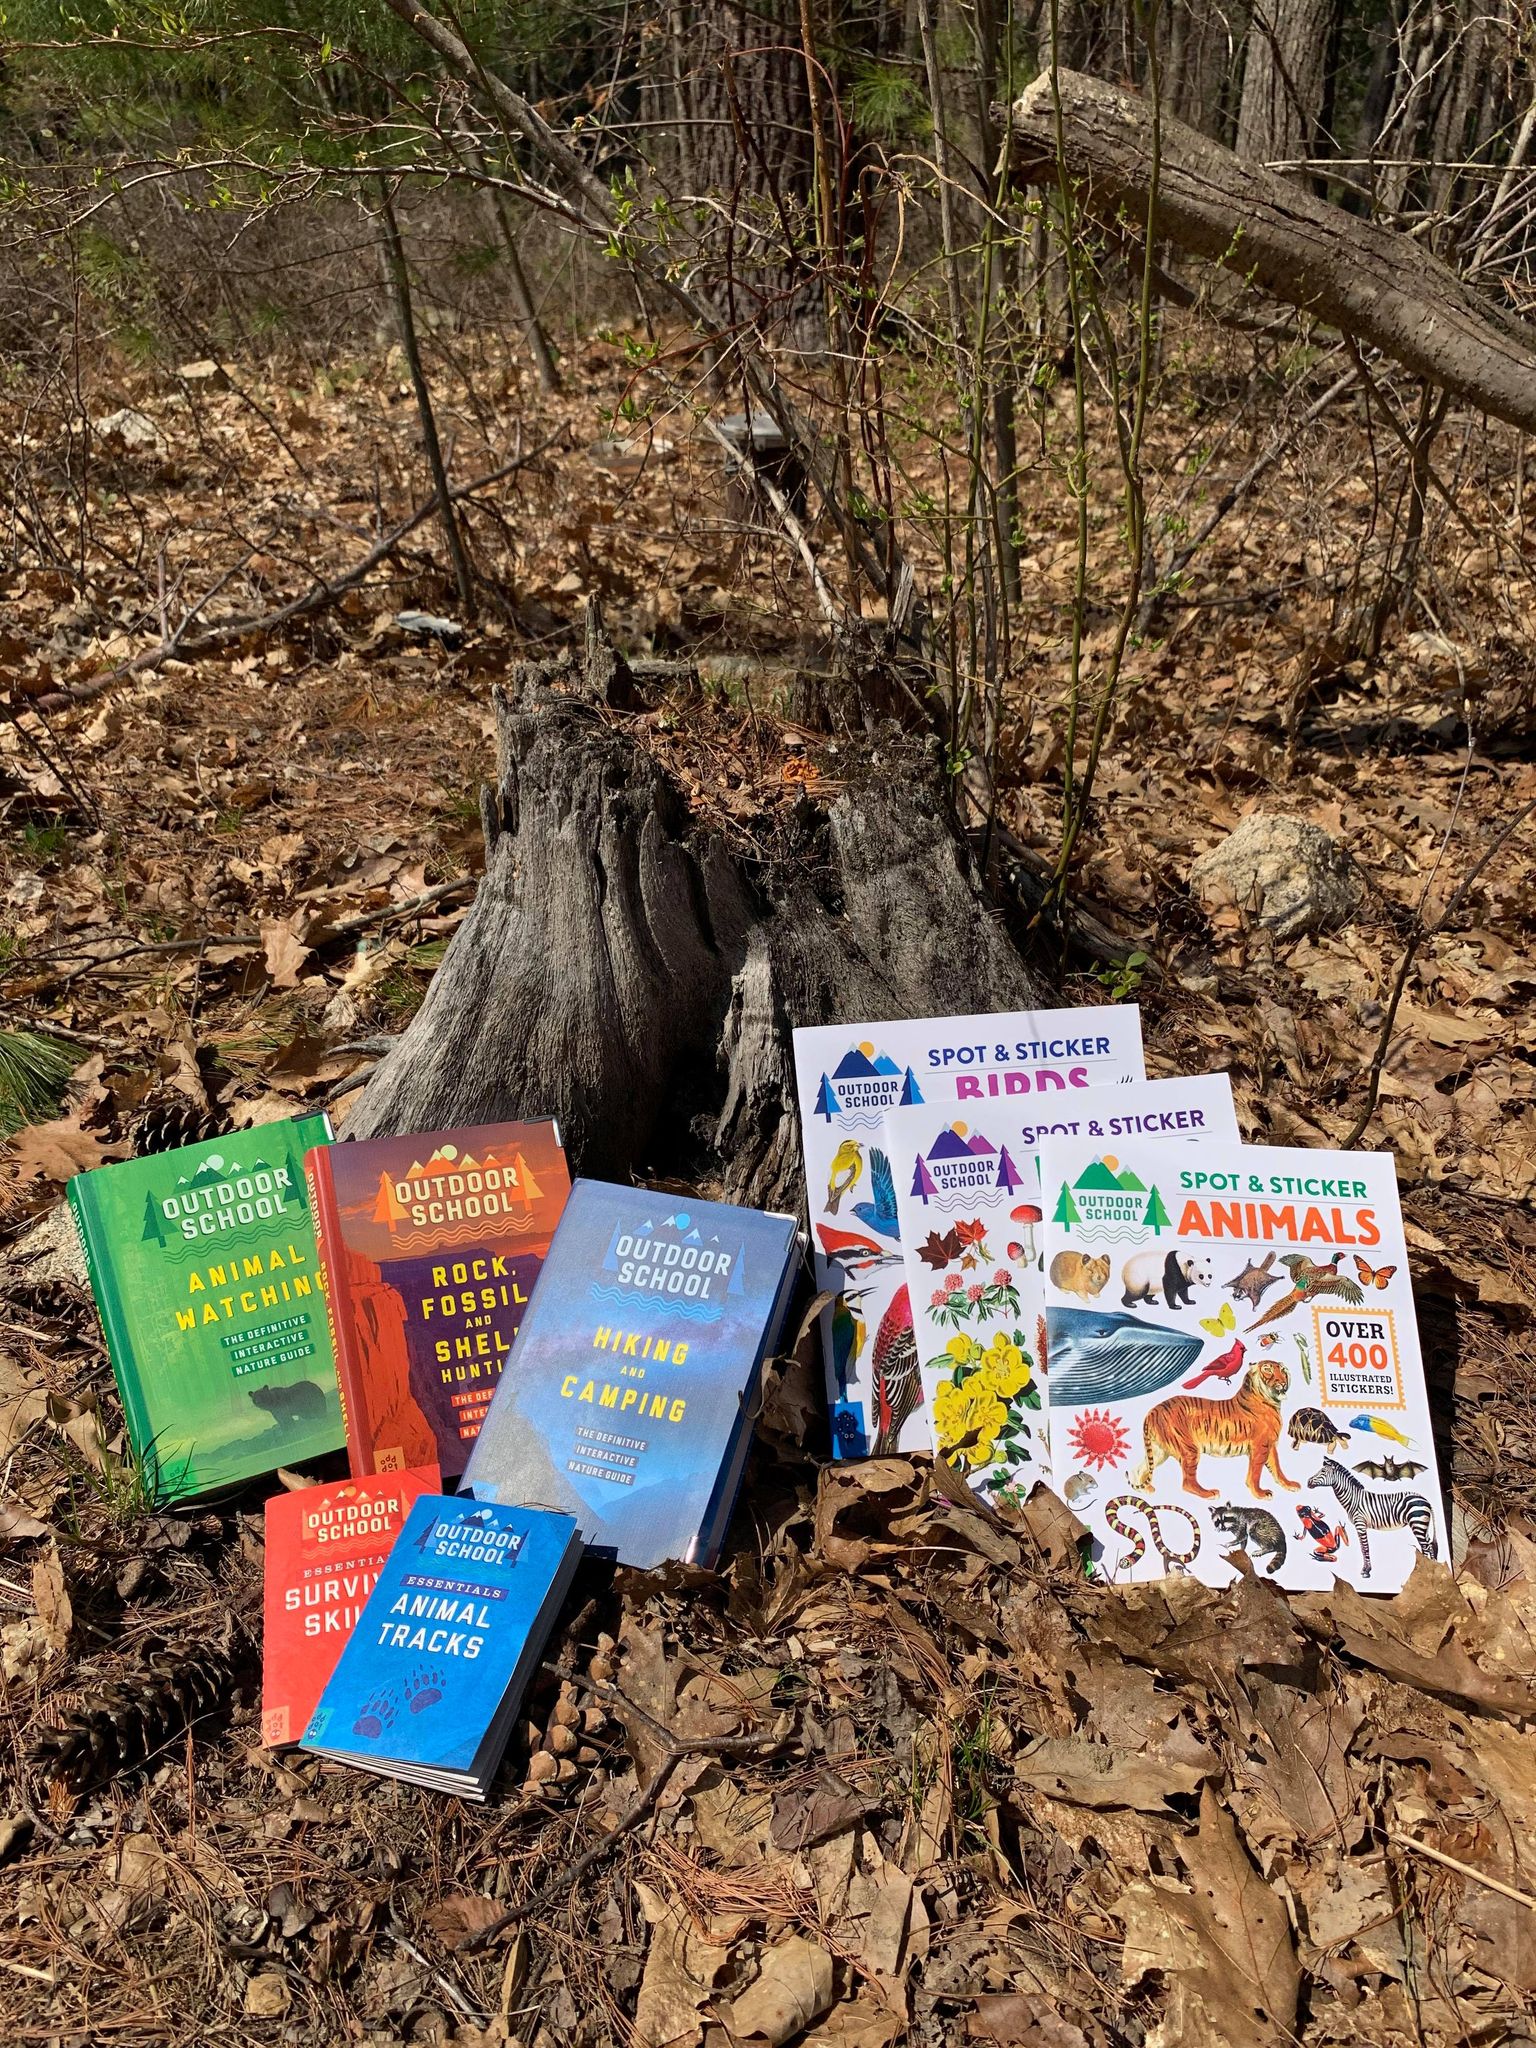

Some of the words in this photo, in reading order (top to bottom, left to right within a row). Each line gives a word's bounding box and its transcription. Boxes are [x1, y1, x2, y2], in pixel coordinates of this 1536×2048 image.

[928, 1045, 987, 1067] SPOT
[994, 1044, 1010, 1062] &
[1015, 1036, 1110, 1060] STICKER
[837, 1081, 899, 1096] OUTDOOR
[845, 1094, 895, 1108] SCHOOL
[1088, 1120, 1104, 1136] &
[1108, 1109, 1205, 1135] STICKER
[933, 1160, 995, 1178] OUTDOOR
[941, 1174, 992, 1189] SCHOOL
[162, 1167, 293, 1220] OUTDOOR
[394, 1166, 520, 1205] OUTDOOR
[1179, 1171, 1240, 1192] SPOT
[1248, 1175, 1264, 1193] &
[1271, 1176, 1368, 1198] STICKER
[308, 1172, 322, 1239] OUTDOOR
[410, 1190, 513, 1227] SCHOOL
[1078, 1195, 1143, 1209] OUTDOOR
[1086, 1208, 1138, 1222] SCHOOL
[181, 1194, 288, 1240] SCHOOL
[1177, 1200, 1381, 1246] ANIMALS
[189, 1245, 306, 1294] ANIMAL
[615, 1234, 732, 1277] OUTDOOR
[432, 1255, 516, 1288] ROCK,
[616, 1261, 711, 1300] SCHOOL
[421, 1283, 528, 1320] FOSSIL
[224, 1333, 246, 1346] THE
[247, 1315, 306, 1340] DEFINITIVE
[465, 1314, 492, 1329] AND
[1326, 1321, 1385, 1339] OVER
[234, 1331, 304, 1359] INTERACTIVE
[435, 1327, 519, 1362] SHEL
[592, 1326, 690, 1366] HIKING
[1328, 1342, 1388, 1370] 400
[235, 1356, 278, 1376] NATURE
[279, 1345, 311, 1362] GUIDE
[620, 1365, 646, 1379] AND
[1329, 1373, 1392, 1383] ILLUSTRATED
[1331, 1383, 1394, 1395] STICKERS!
[454, 1394, 473, 1405] THE
[560, 1375, 686, 1423] CAMPING
[577, 1427, 594, 1439] THE
[595, 1432, 646, 1451] DEFINITIVE
[576, 1444, 636, 1467] INTERACTIVE
[568, 1461, 604, 1477] NATURE
[605, 1470, 632, 1484] GUIDE
[308, 1498, 399, 1529] OUTDOOR
[317, 1516, 391, 1543] SCHOOL
[435, 1523, 522, 1551] OUTDOOR
[304, 1554, 391, 1579] ESSENTIA
[435, 1540, 505, 1565] SCHOOL
[407, 1576, 502, 1599] ESSENTIALS
[390, 1593, 491, 1629] ANIMAL
[377, 1623, 484, 1659] TRACKS
